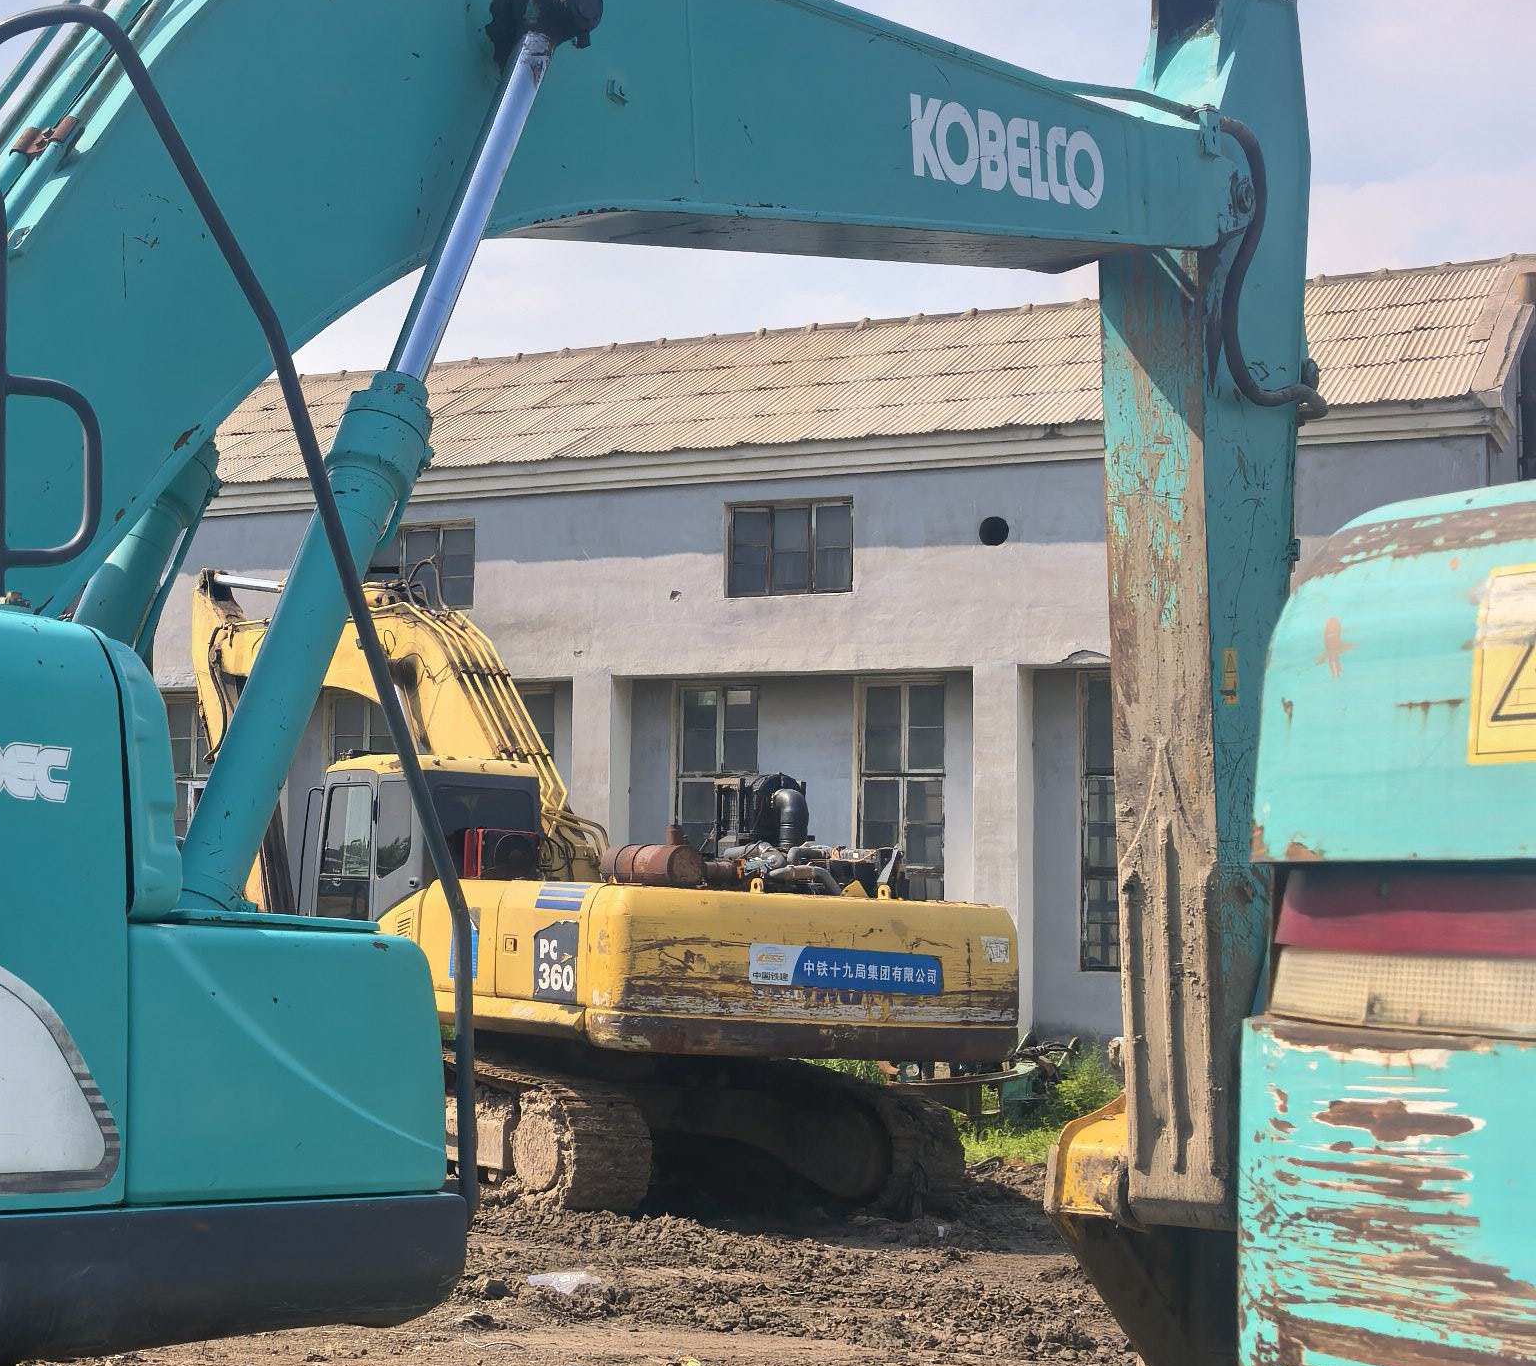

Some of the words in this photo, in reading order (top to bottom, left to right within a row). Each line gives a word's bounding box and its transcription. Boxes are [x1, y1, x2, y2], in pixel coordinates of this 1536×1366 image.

[909, 93, 1105, 210] KOBELCO
[539, 938, 558, 961] PC
[538, 962, 574, 992] 360
[803, 960, 937, 985] 中铁十九局集团有限公司
